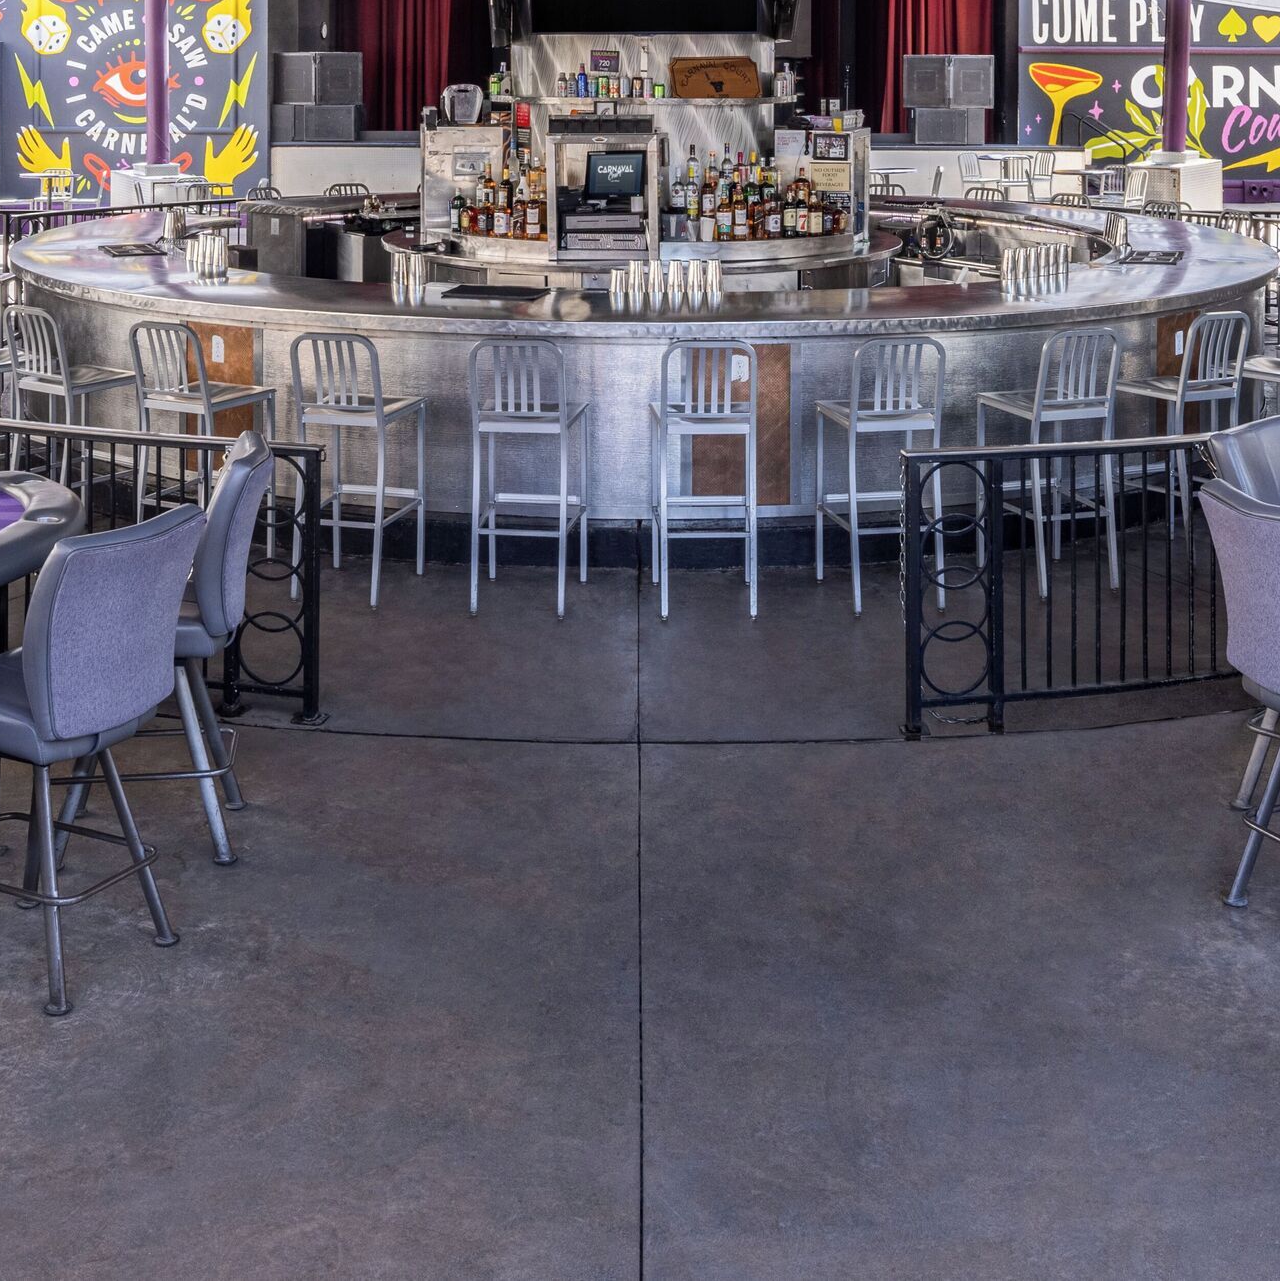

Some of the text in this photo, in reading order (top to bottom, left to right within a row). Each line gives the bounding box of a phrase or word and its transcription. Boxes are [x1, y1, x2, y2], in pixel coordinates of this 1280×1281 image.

[76, 9, 136, 54] CAME
[168, 23, 209, 69] SAW
[680, 61, 751, 87] CARNAVAL COURT
[74, 93, 208, 155] CARNAL'D
[597, 165, 634, 174] CARNAVAL
